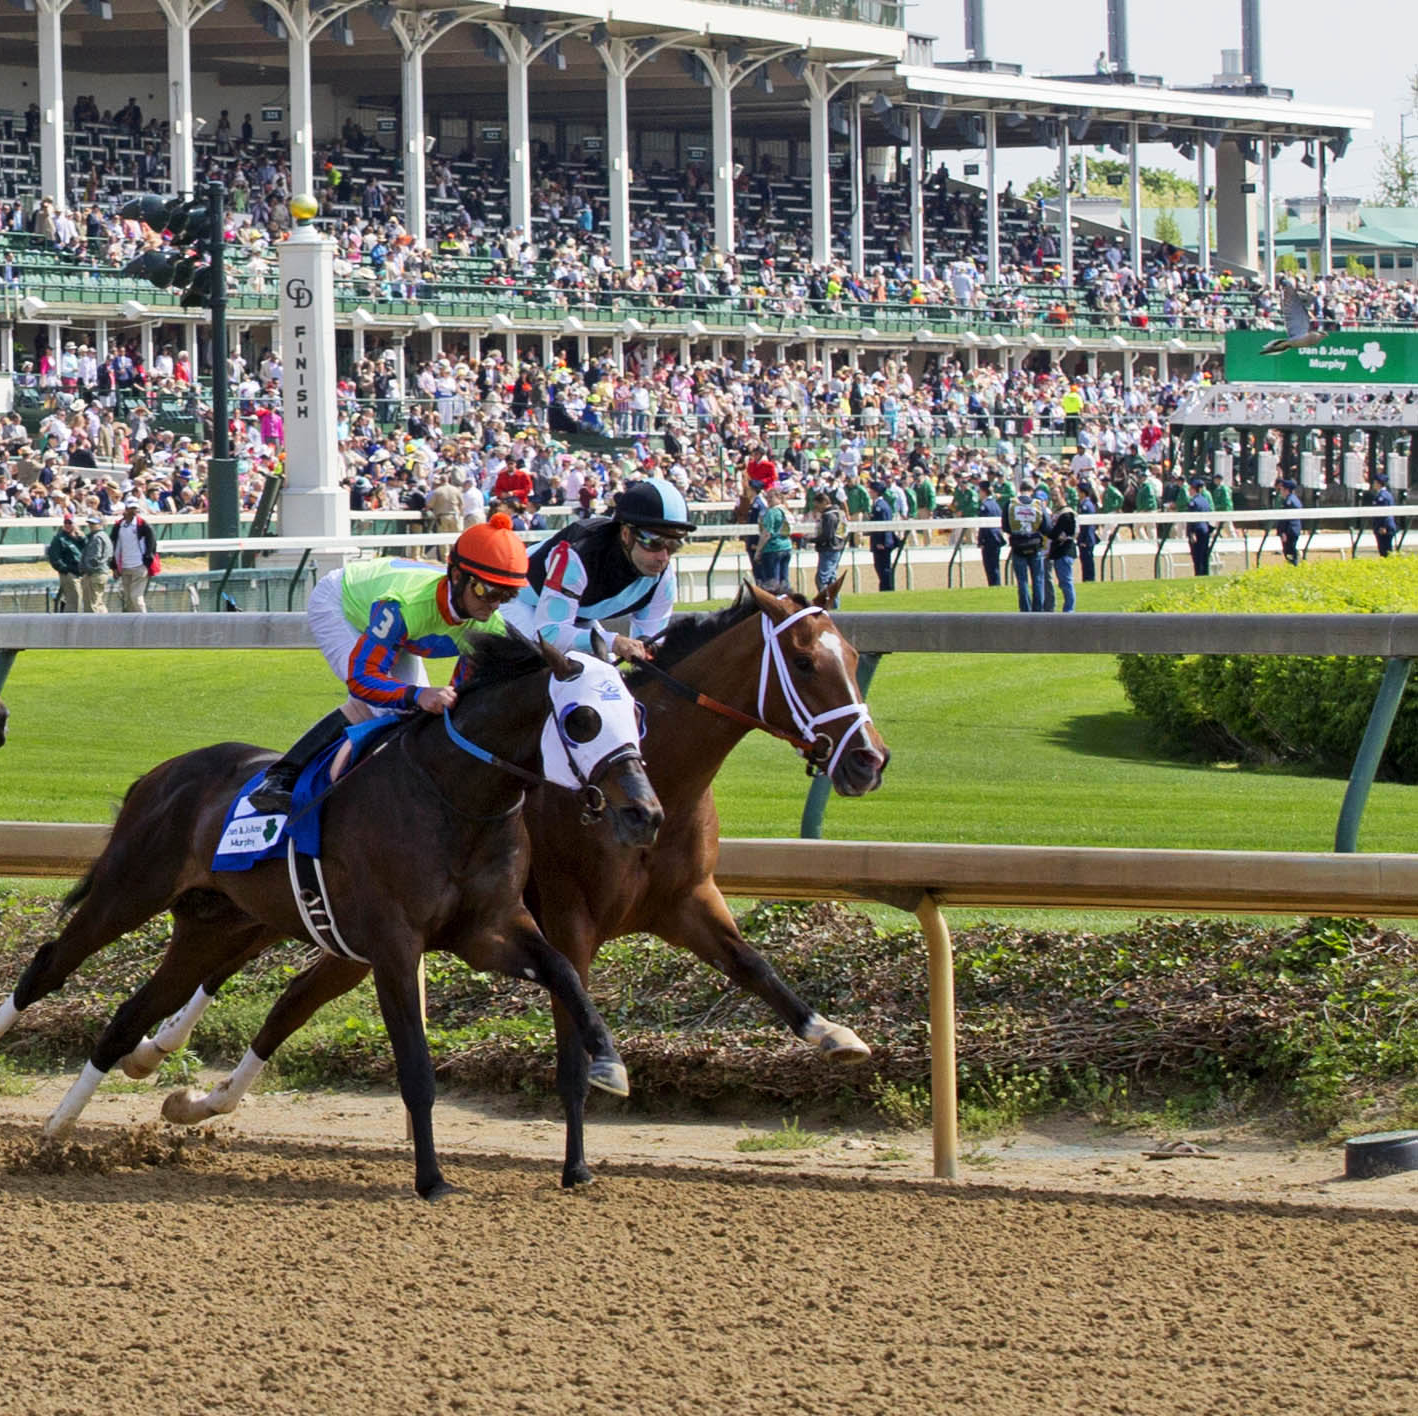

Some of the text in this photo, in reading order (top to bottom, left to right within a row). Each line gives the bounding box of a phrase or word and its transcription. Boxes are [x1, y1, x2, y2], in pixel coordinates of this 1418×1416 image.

[1298, 346, 1358, 356] Dan & JoAnn
[1309, 358, 1347, 371] Murphy
[295, 325, 308, 419] FINISH
[546, 552, 561, 581] 1
[372, 607, 394, 639] 3
